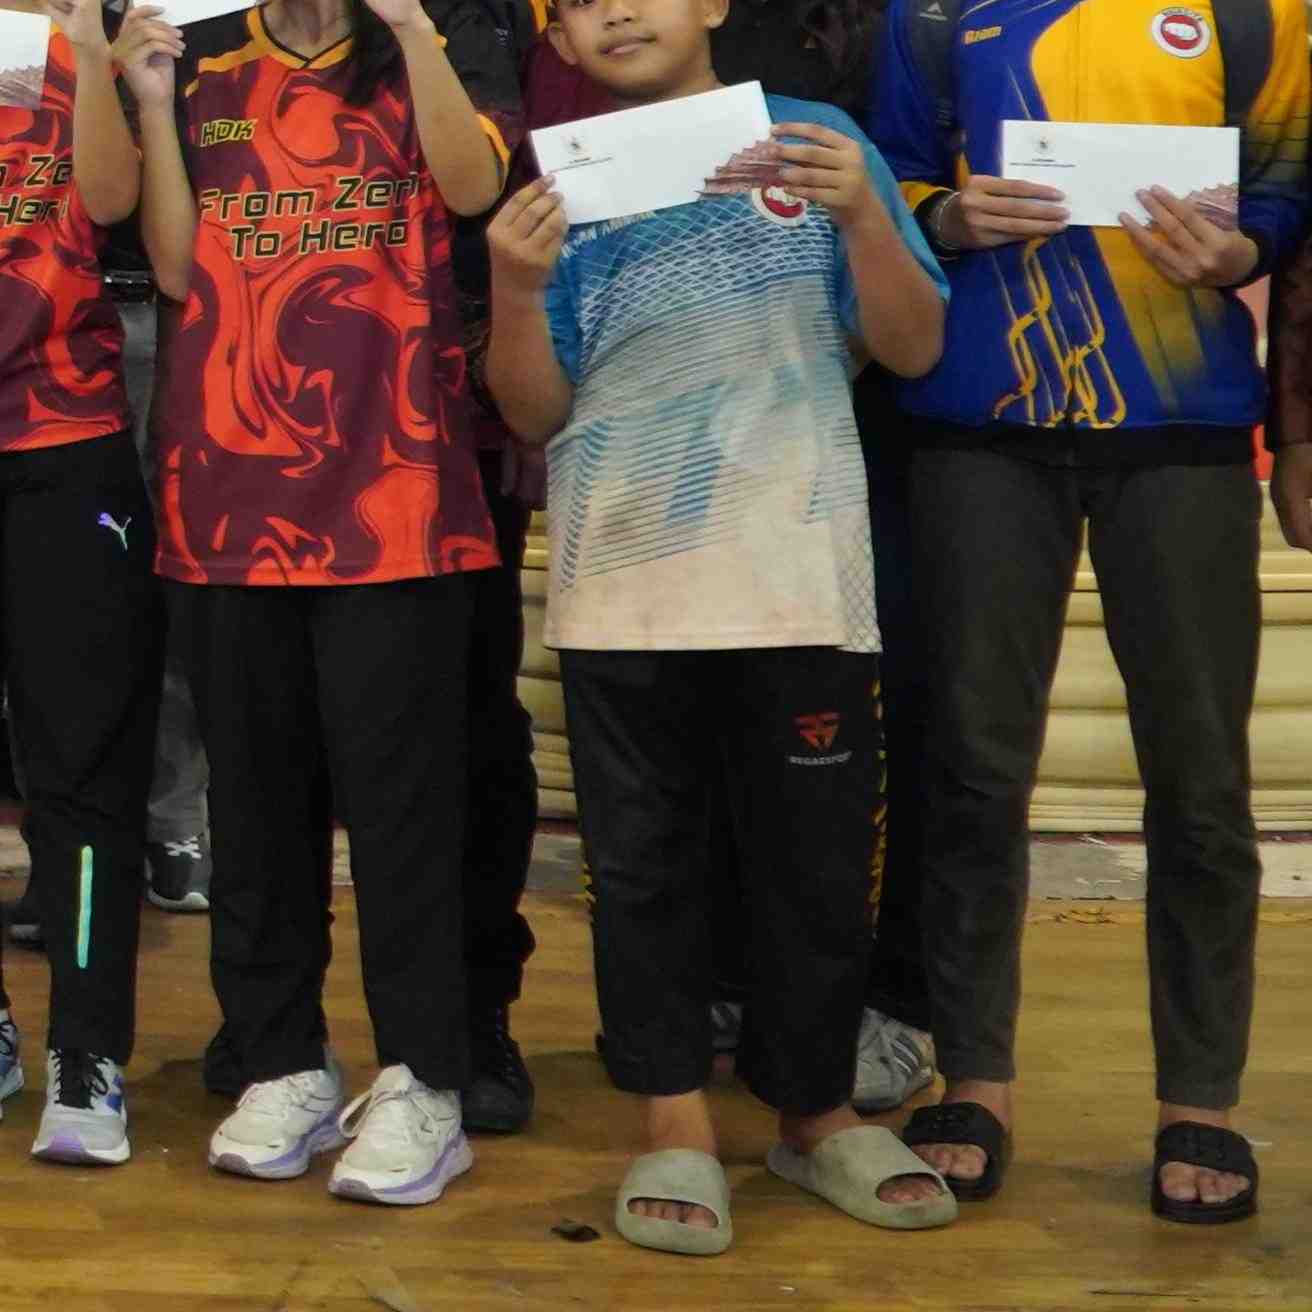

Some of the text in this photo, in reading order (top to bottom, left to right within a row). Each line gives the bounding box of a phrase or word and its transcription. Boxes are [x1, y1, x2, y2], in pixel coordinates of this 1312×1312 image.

[24, 153, 74, 188] Ze
[199, 171, 419, 223] From Zer
[230, 218, 409, 260] To Hero
